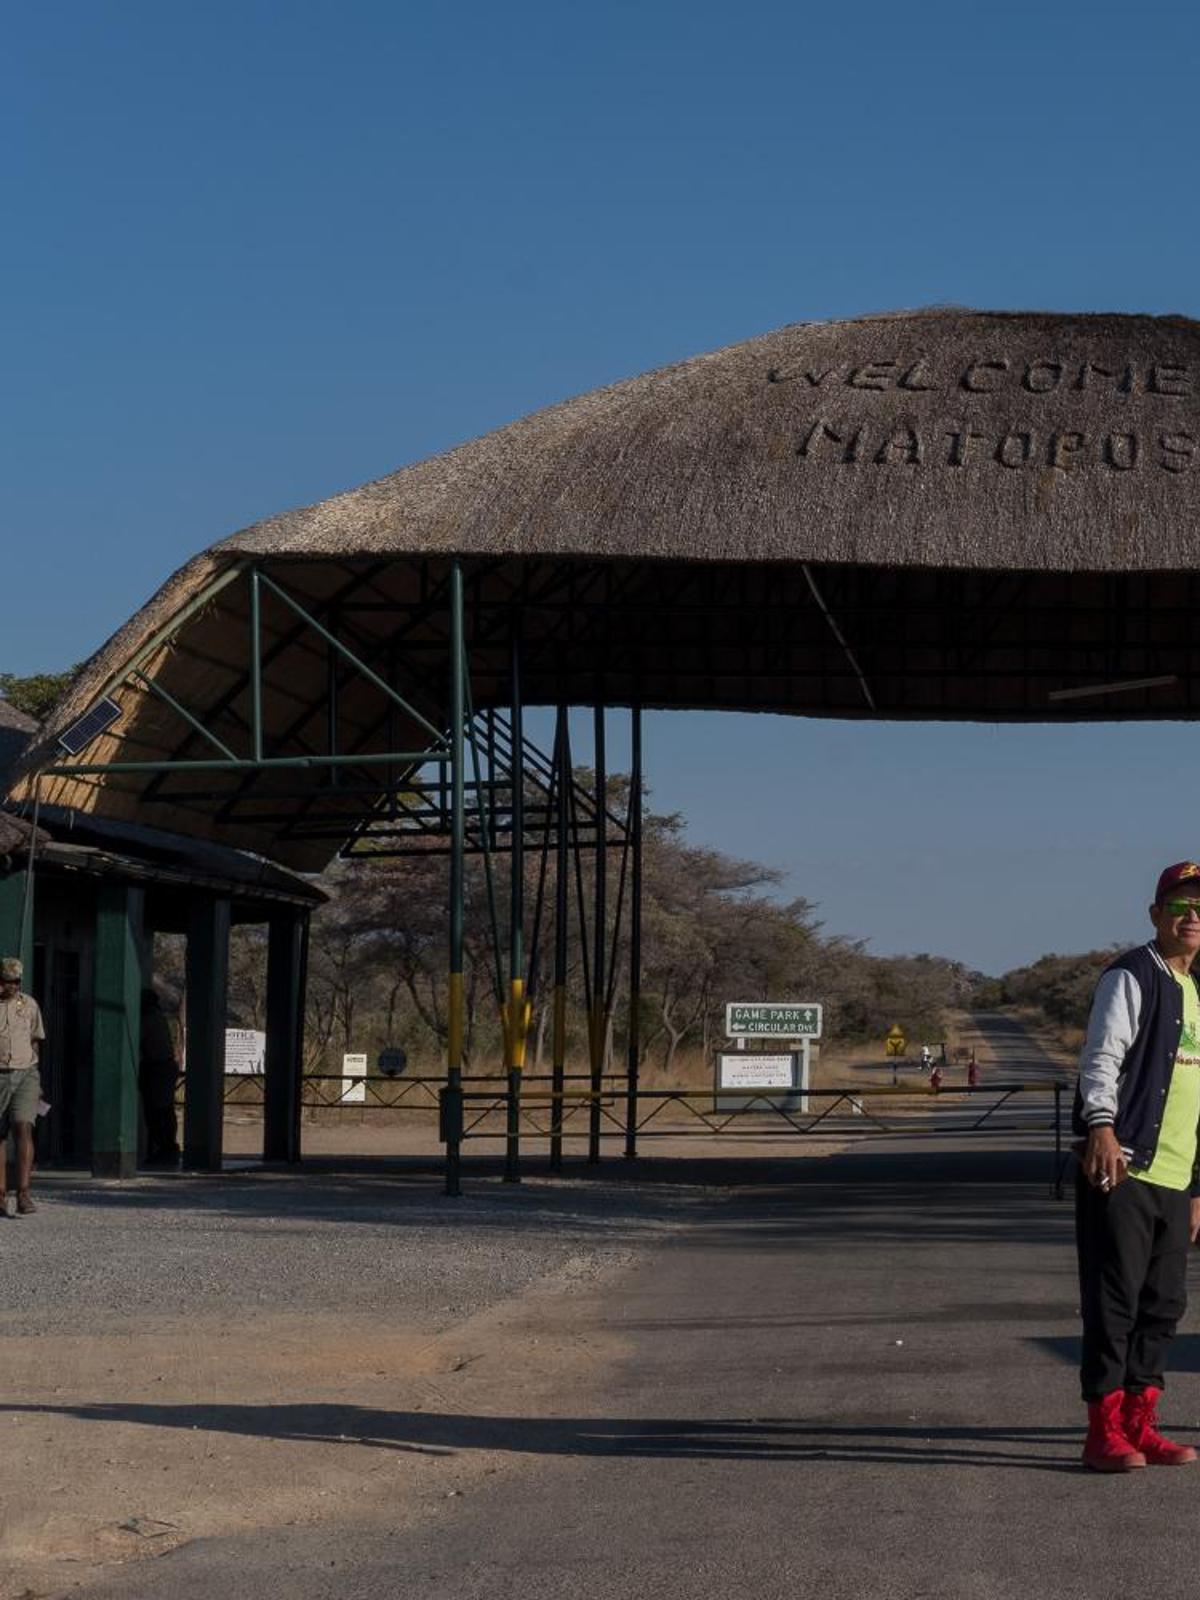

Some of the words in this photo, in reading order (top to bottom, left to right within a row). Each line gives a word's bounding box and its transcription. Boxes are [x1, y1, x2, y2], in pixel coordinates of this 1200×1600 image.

[767, 359, 1190, 397] WELCOME
[798, 420, 1200, 474] MATOPOS
[735, 1008, 768, 1020] GAME
[771, 1010, 801, 1020] PARK
[748, 1023, 796, 1032] CIRCULAR
